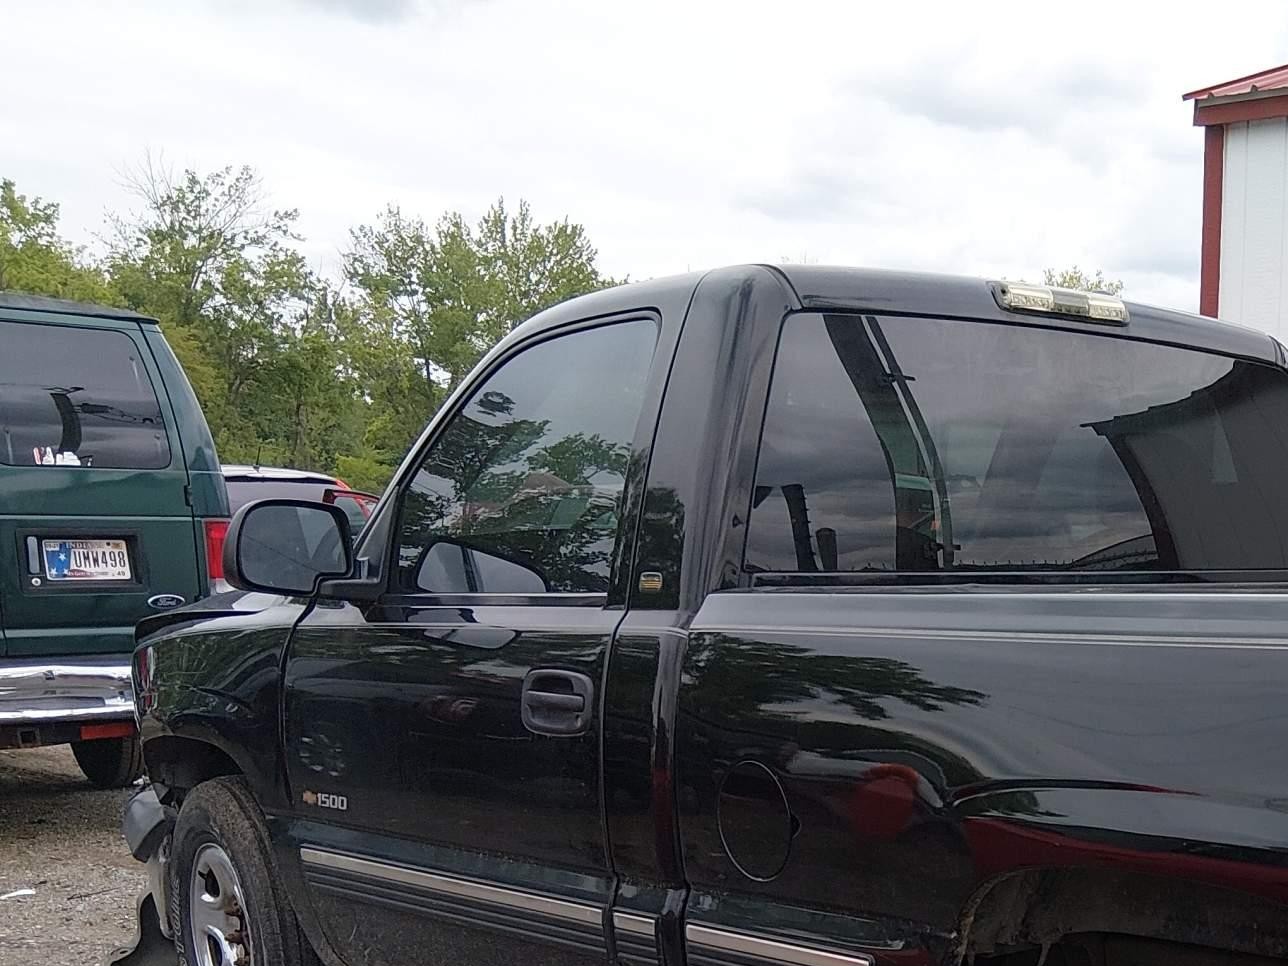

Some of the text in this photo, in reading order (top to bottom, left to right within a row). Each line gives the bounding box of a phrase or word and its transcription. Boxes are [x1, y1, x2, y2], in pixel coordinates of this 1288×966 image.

[65, 542, 105, 550] INDIA
[73, 550, 126, 569] UMW498
[317, 792, 348, 810] 1500
